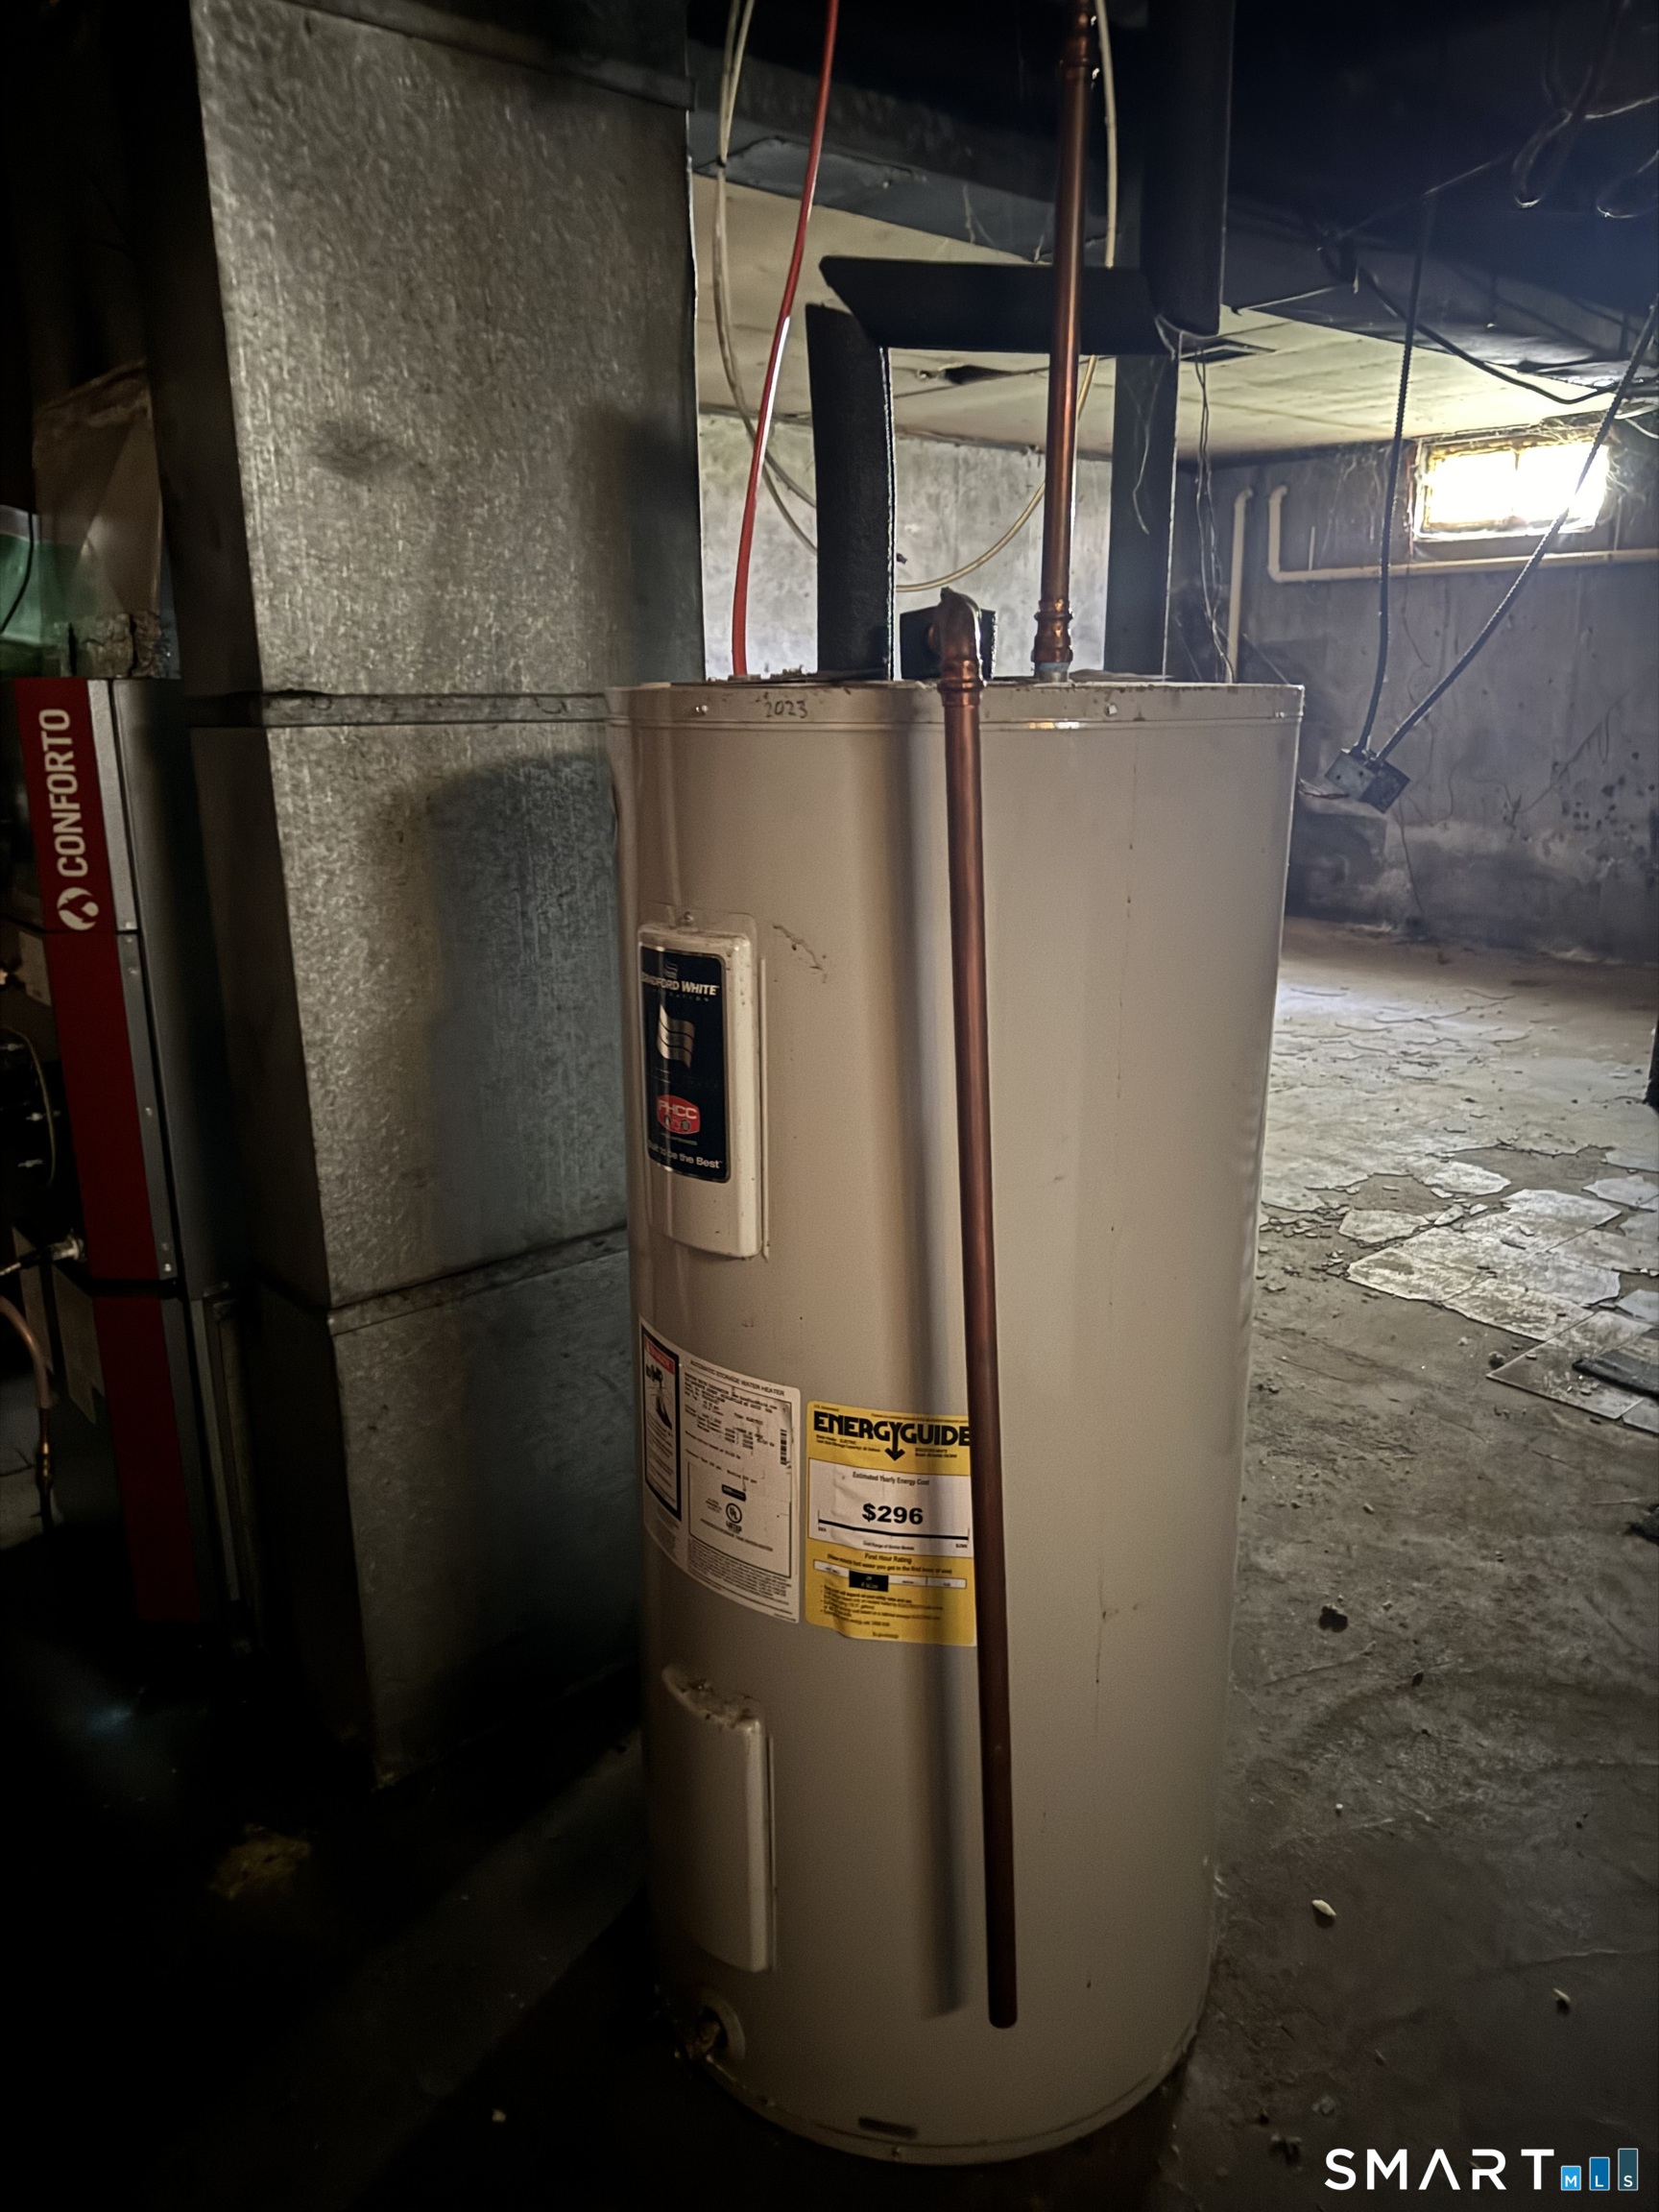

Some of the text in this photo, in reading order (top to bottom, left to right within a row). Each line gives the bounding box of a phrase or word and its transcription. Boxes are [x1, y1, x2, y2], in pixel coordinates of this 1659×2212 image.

[764, 700, 807, 718] 2023
[38, 709, 88, 878] CONFORTO
[681, 980, 719, 996] WHITE
[696, 1157, 720, 1168] Best
[761, 1385, 784, 1397] HEATER
[813, 1410, 971, 1448] ENERGYGUIDE
[853, 1471, 879, 1481] Estimated
[879, 1475, 896, 1484] Yearly
[897, 1477, 916, 1486] Energy
[861, 1503, 924, 1525] $296
[893, 1555, 912, 1564] Rating
